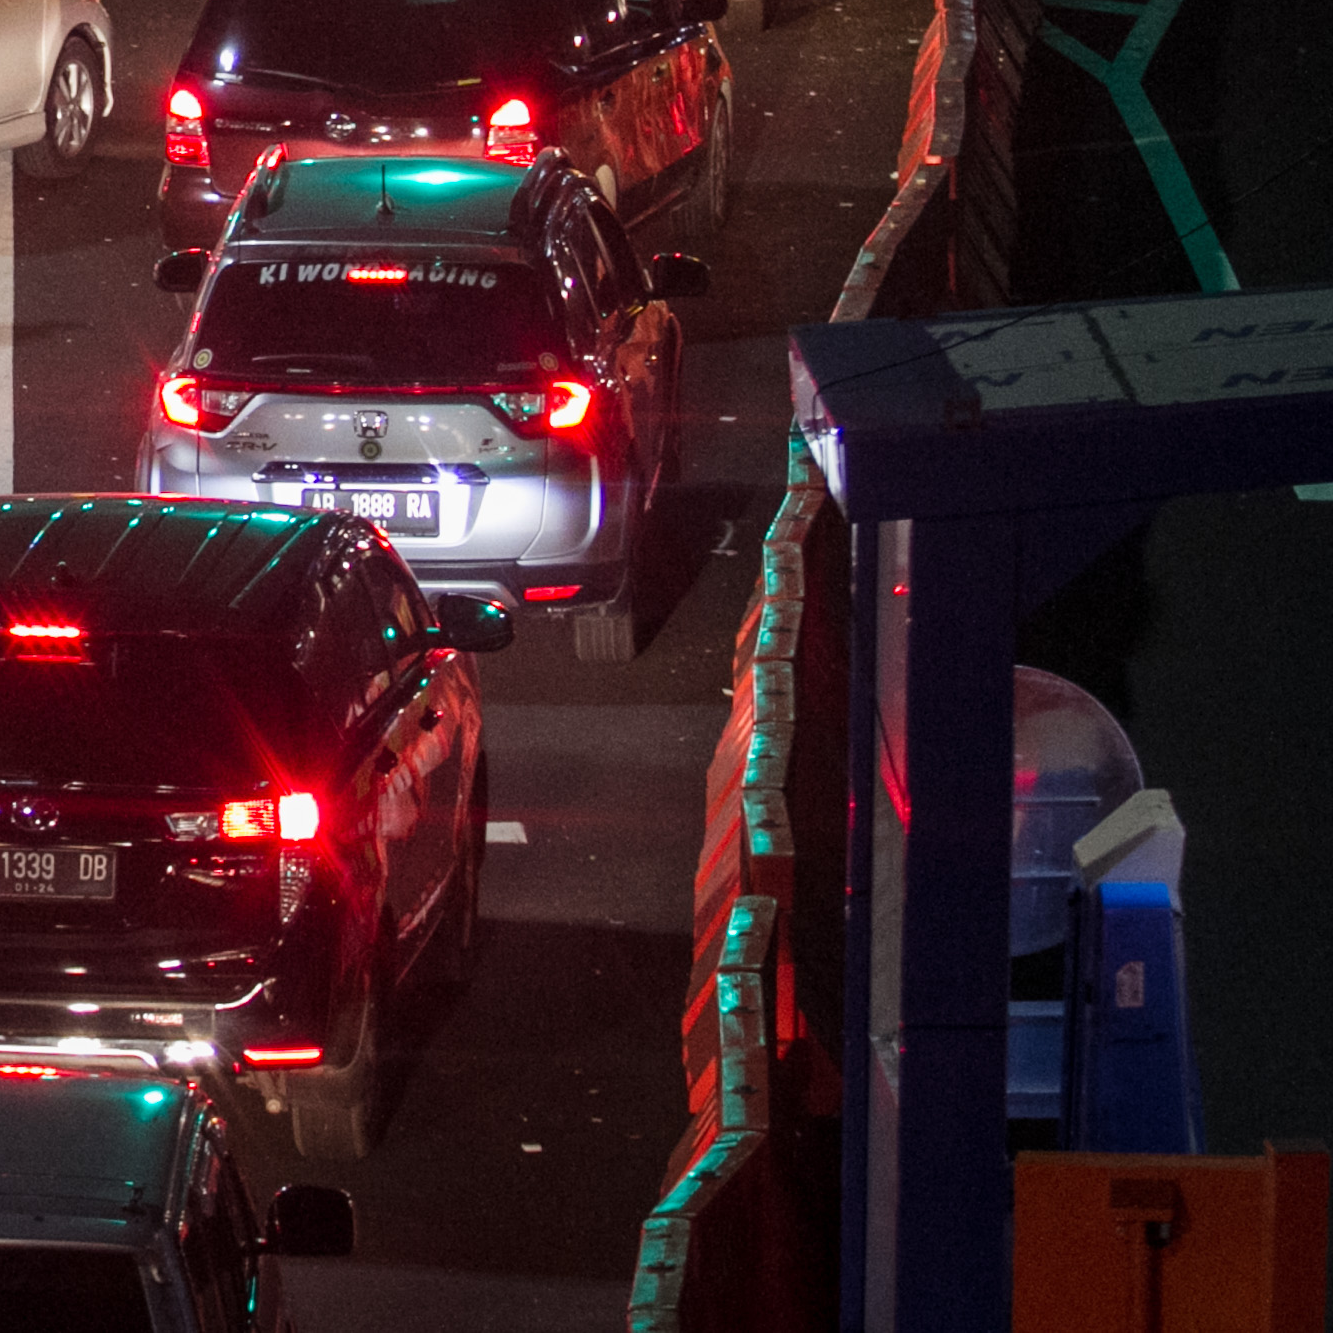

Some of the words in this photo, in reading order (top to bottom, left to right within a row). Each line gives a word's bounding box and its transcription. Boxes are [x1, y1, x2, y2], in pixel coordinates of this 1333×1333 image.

[260, 264, 288, 285] KI
[351, 493, 395, 518] 1888
[406, 494, 432, 518] RA
[1, 852, 55, 880] 1339
[79, 854, 107, 881] DB
[15, 883, 54, 893] 01-24
